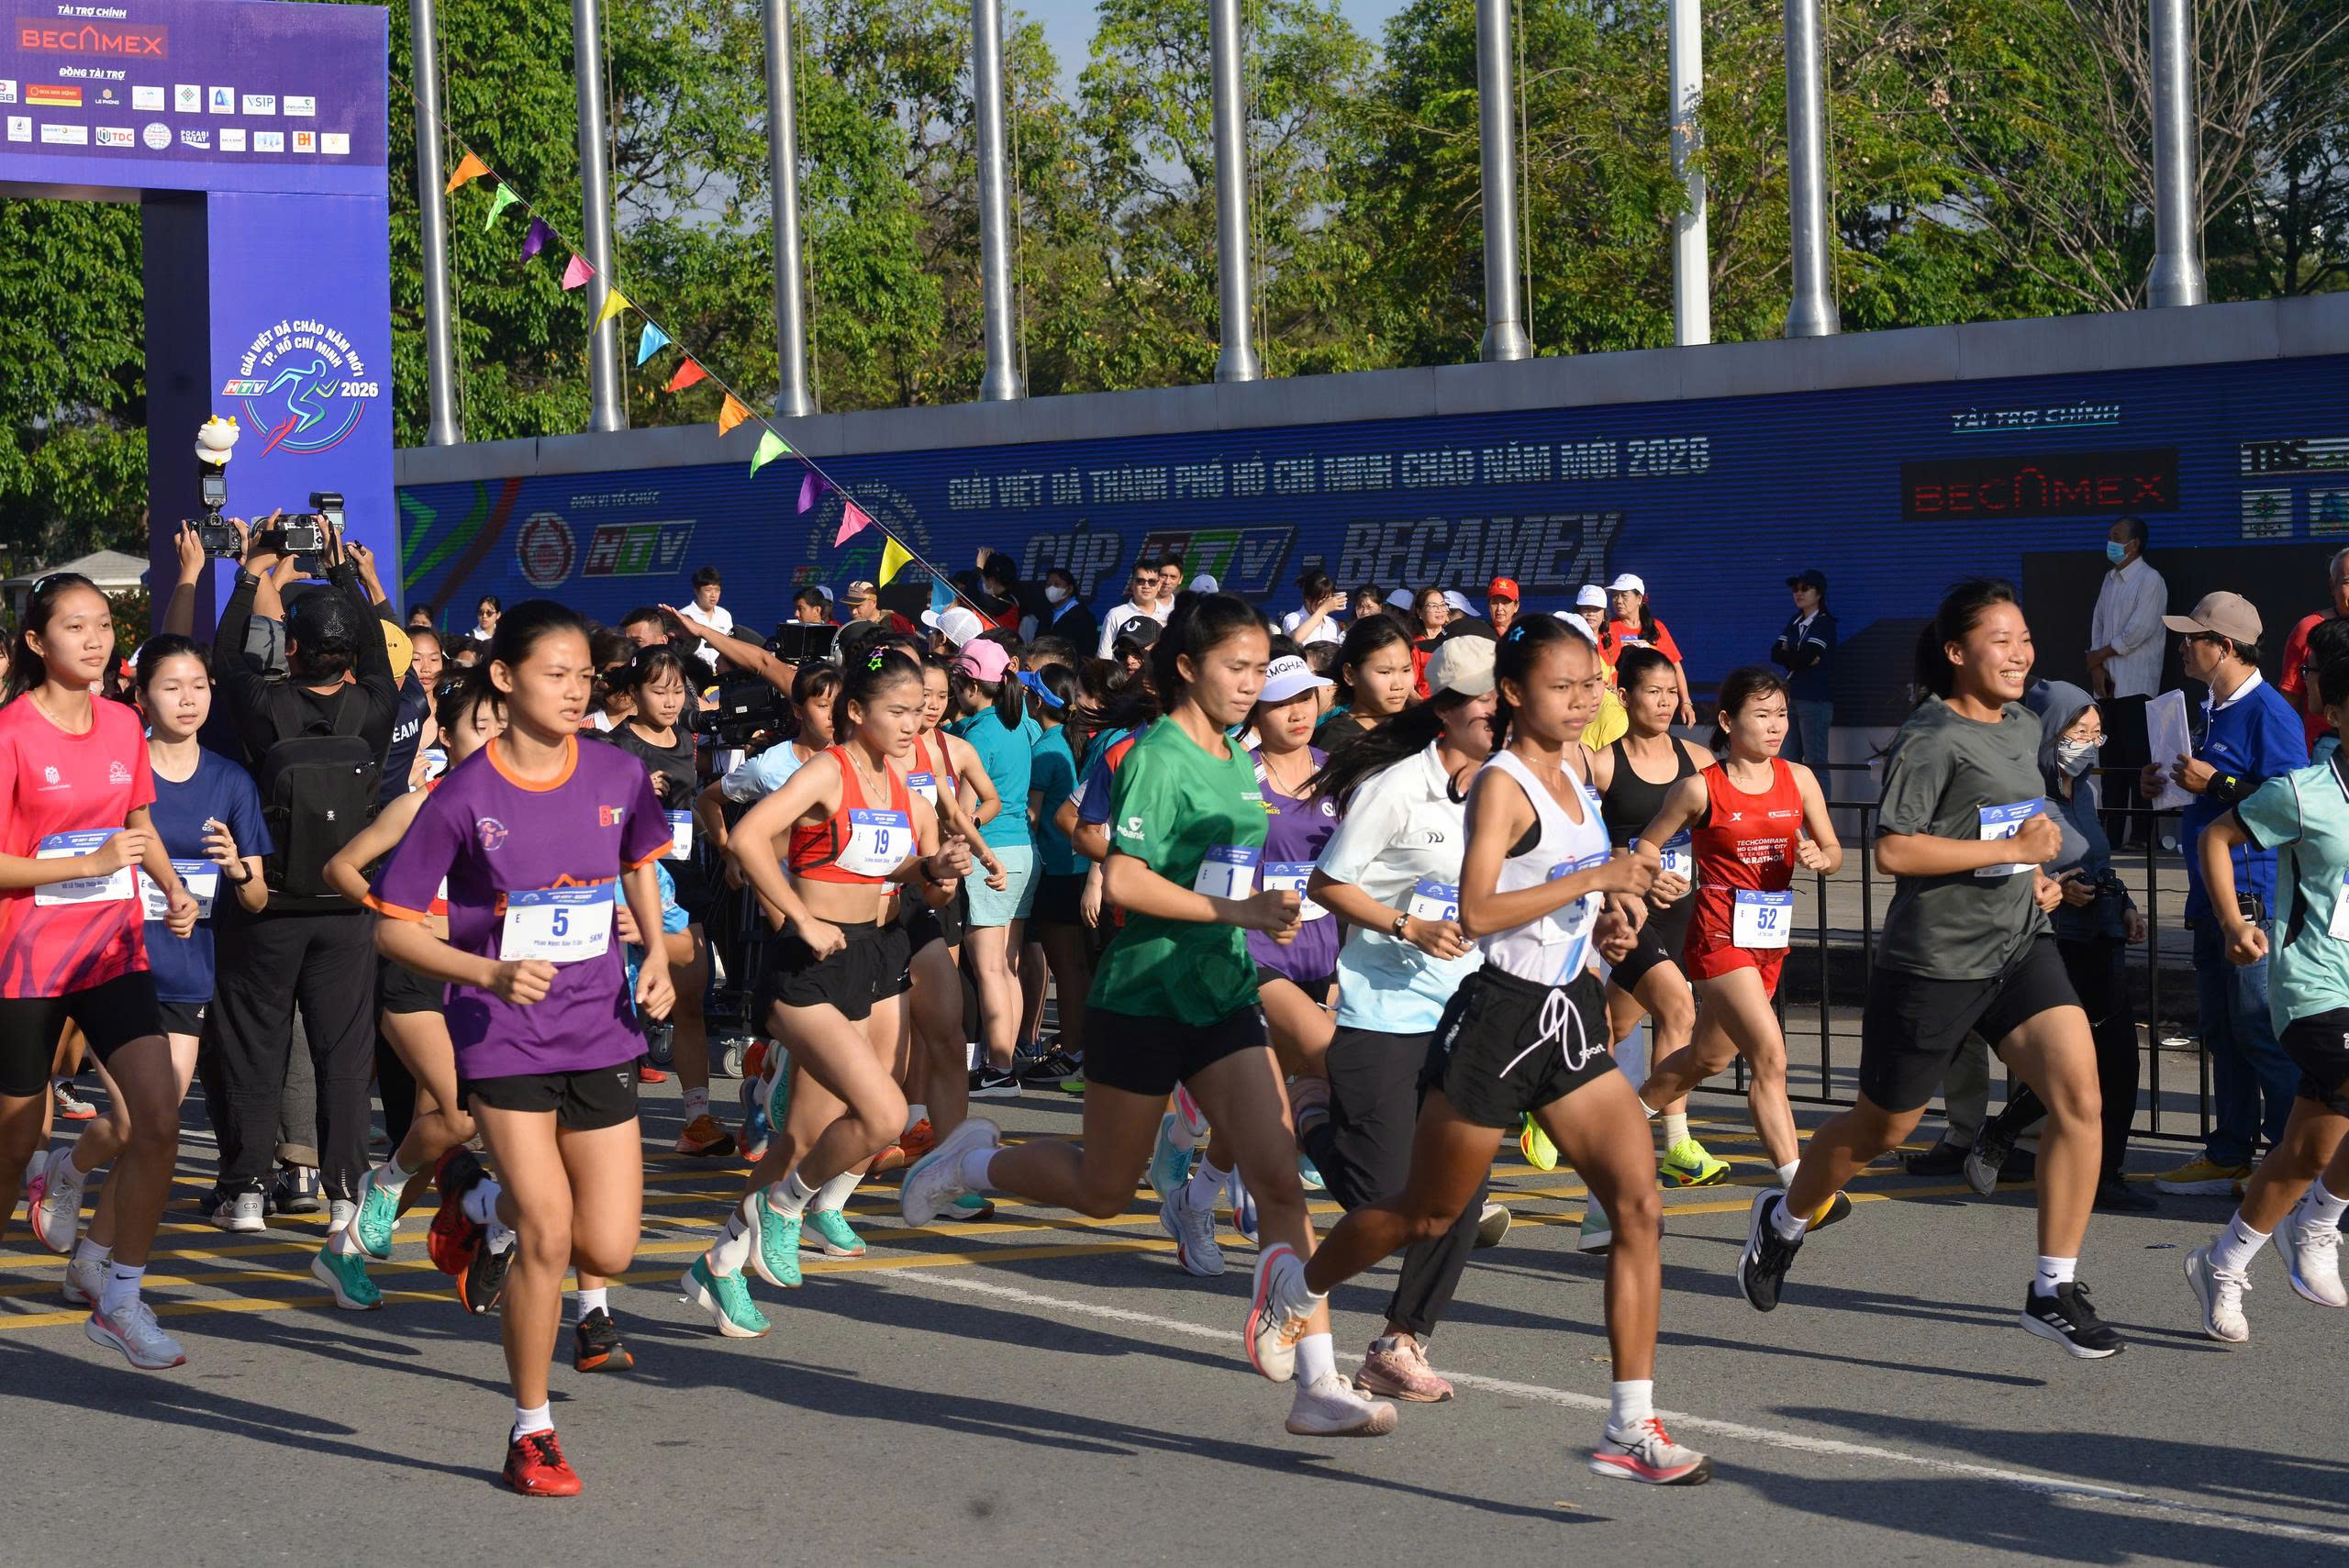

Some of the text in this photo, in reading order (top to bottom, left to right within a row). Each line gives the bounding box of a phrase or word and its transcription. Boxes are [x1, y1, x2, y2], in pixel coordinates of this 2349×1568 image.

[58, 5, 127, 17] TÀI TRỢ CHÍNH
[22, 24, 162, 54] BECAMEX
[60, 66, 126, 80] ĐỒNG TÀI TRỢ
[112, 132, 133, 142] TDC
[240, 352, 258, 376] GIẢI
[252, 330, 274, 352] VIỆT
[294, 319, 325, 336] CHÀO
[325, 328, 351, 352] NĂM
[346, 351, 364, 377] MỚI
[262, 336, 342, 368] TP. HỒ CHÍ MINH
[223, 381, 267, 395] HTV
[340, 382, 379, 397] 2026
[948, 470, 992, 510] GIẢI
[1088, 462, 1167, 503] THÀNH
[1274, 452, 1317, 494] CHÍ
[1401, 445, 1475, 488] CHÀO
[1482, 441, 1552, 484] NĂM
[1914, 466, 2166, 512] BECAMEX
[585, 526, 692, 572] HTV
[1019, 517, 1123, 596] CÚP
[1336, 512, 1622, 589] BECAMEX
[392, 718, 419, 743] EAM
[599, 806, 627, 827] BT
[874, 829, 889, 854] 19
[1737, 838, 1788, 846] TECHCOMBANK
[552, 908, 569, 936] 5
[1758, 907, 1777, 929] 52
[1578, 1043, 1606, 1060] sport
